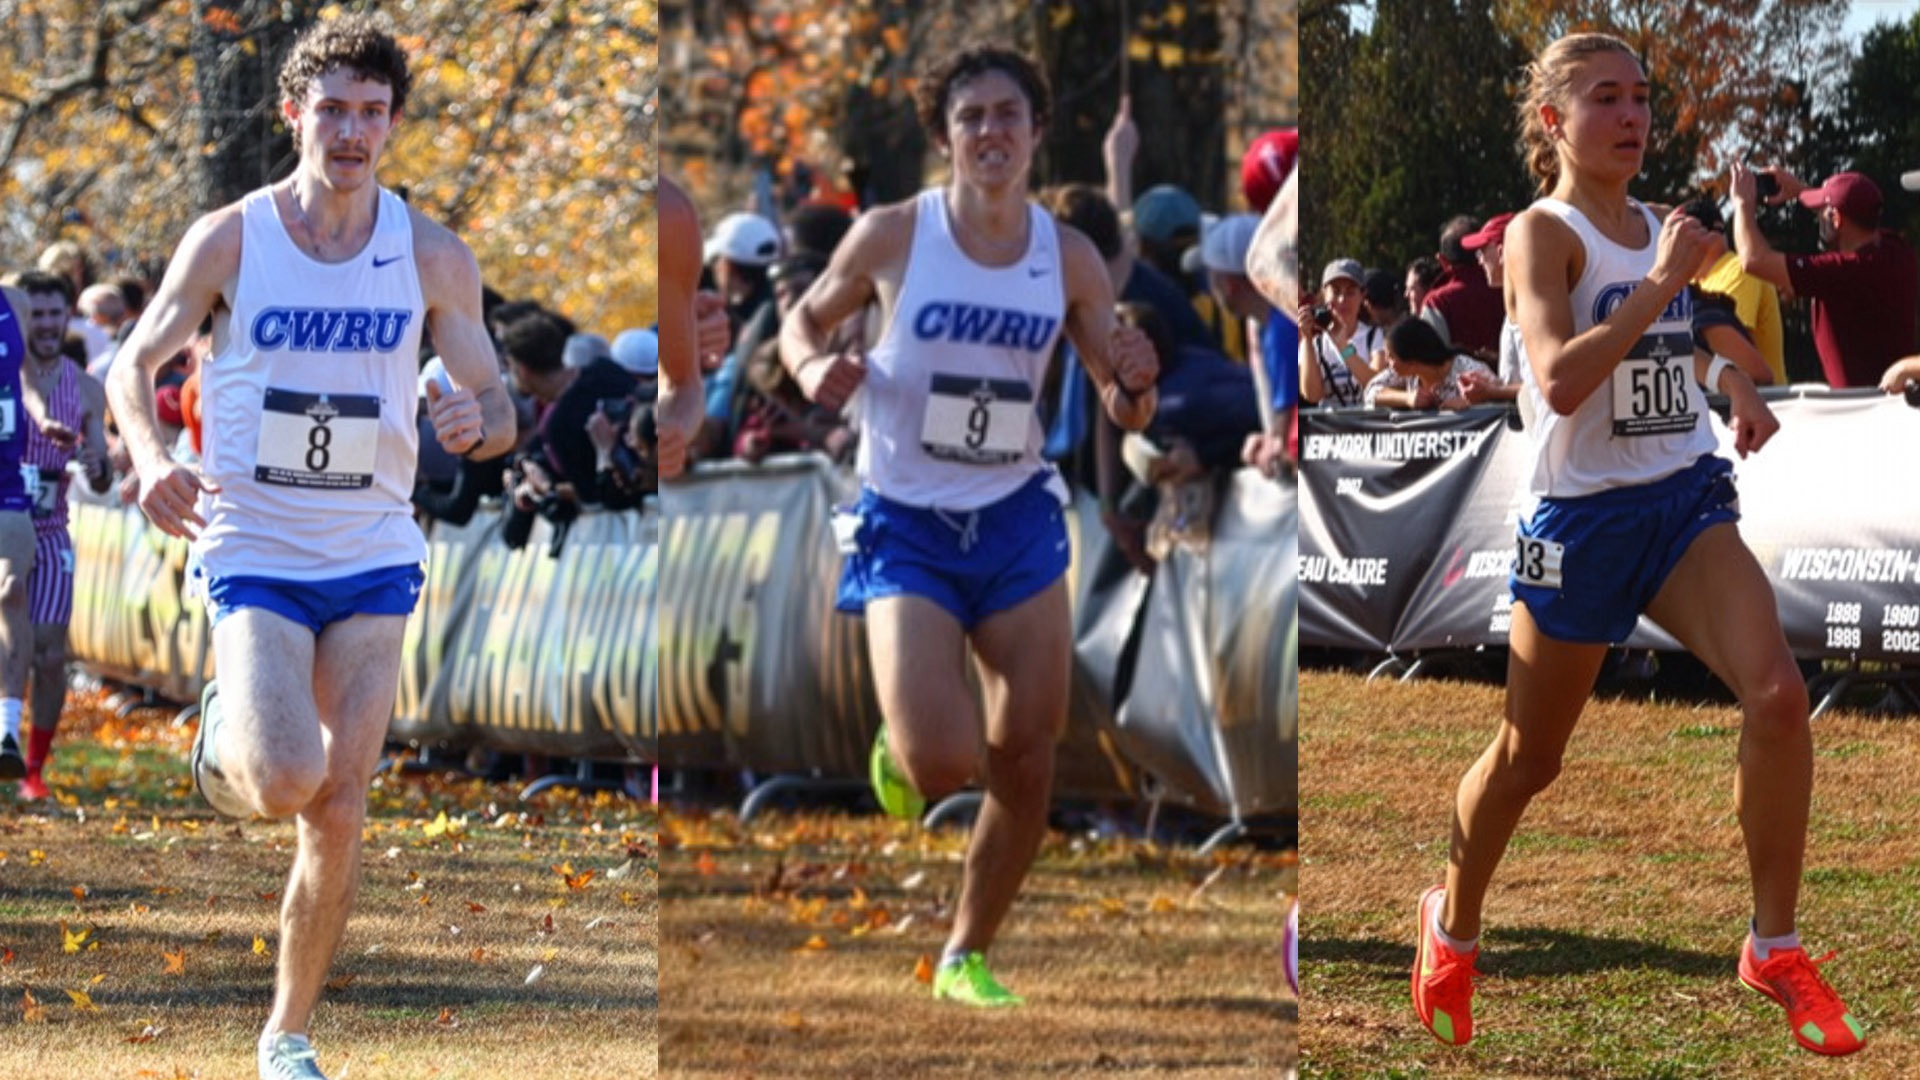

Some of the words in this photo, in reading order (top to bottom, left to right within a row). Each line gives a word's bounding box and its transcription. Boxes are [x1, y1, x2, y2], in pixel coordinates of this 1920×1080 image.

[250, 306, 412, 352] CWRU
[913, 301, 1057, 352] CWRU
[1631, 365, 1688, 417] 503
[305, 425, 331, 471] 8
[964, 404, 990, 449] 9
[1375, 431, 1484, 459] UNIVERSITY
[1327, 557, 1389, 585] CLAIRE
[1781, 547, 1920, 584] WISCONSIN-
[1882, 629, 1920, 653] 2002
